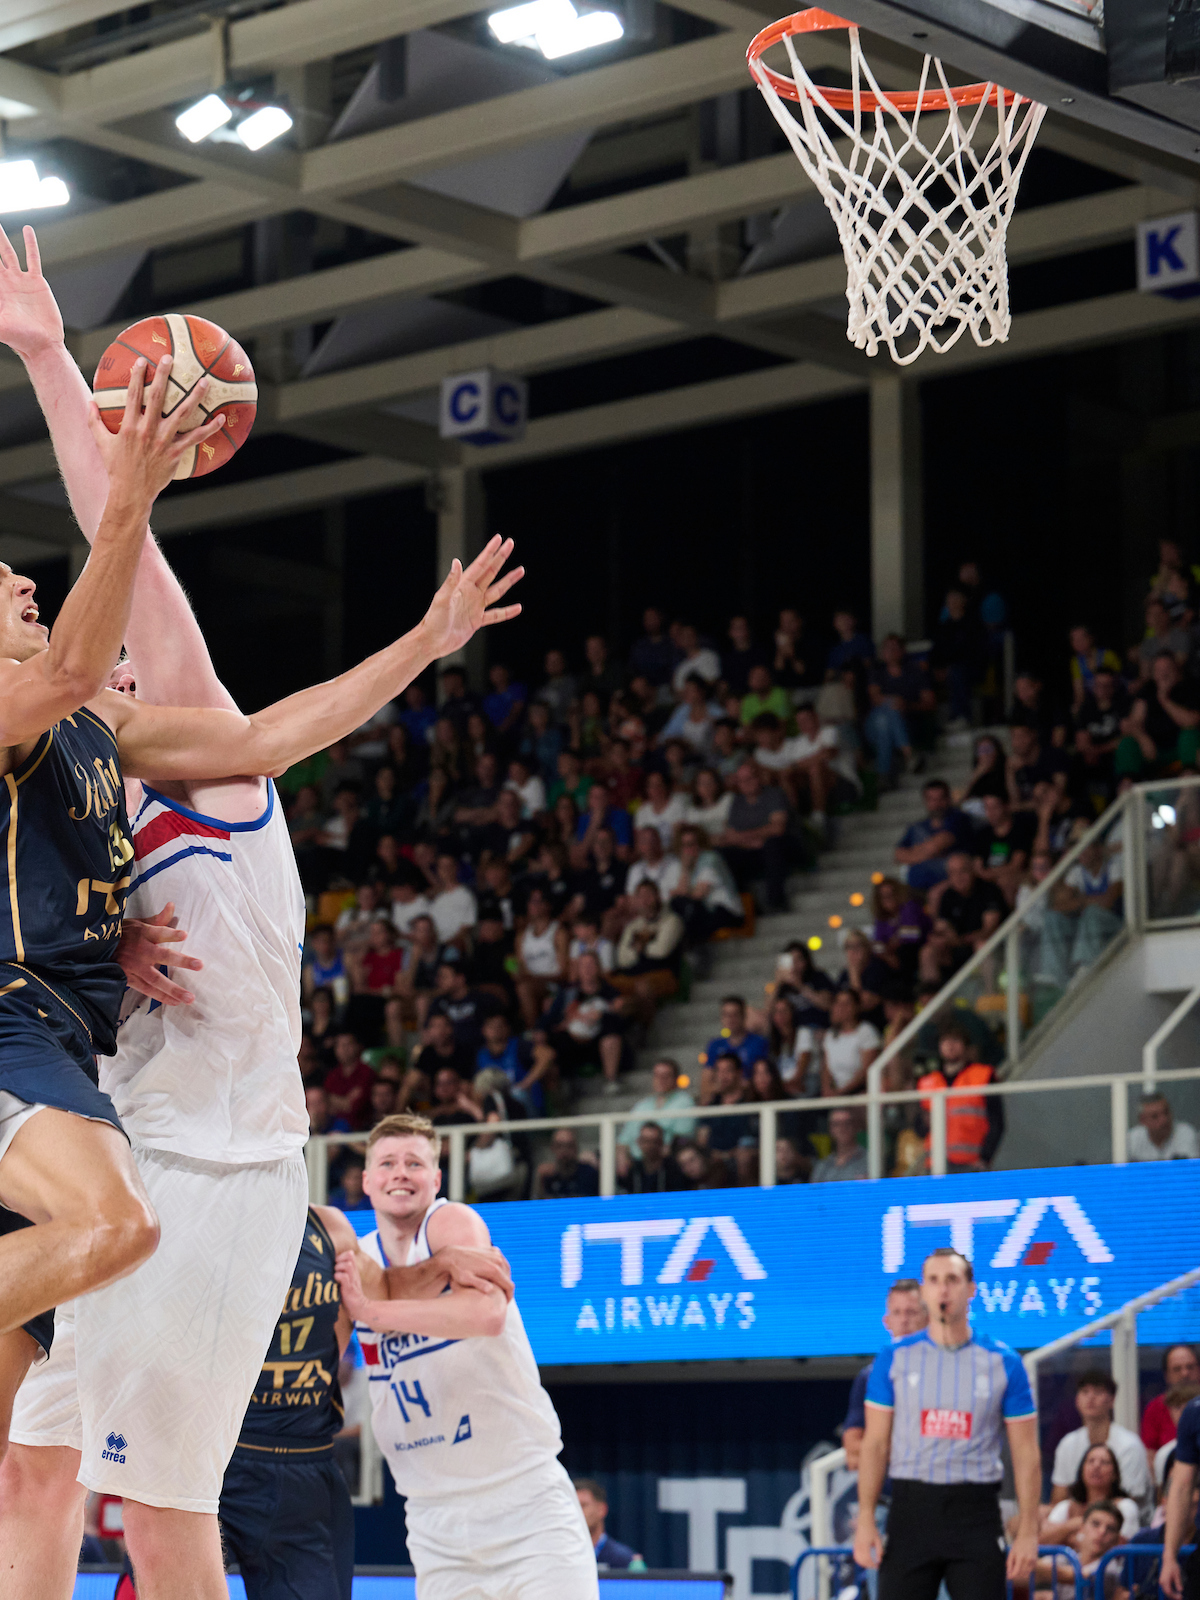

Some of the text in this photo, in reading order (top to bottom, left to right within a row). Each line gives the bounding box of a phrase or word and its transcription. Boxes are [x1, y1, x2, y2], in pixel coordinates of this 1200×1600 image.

[1146, 225, 1186, 277] K
[448, 381, 480, 424] C
[494, 382, 520, 426] C
[75, 875, 132, 917] IT
[560, 1215, 769, 1289] ITA
[882, 1195, 1116, 1274] ITA
[282, 1271, 340, 1314] alia
[574, 1291, 757, 1335] AIRWAYS
[969, 1276, 1103, 1318] WAYS
[279, 1316, 315, 1355] 17
[261, 1359, 332, 1389] TA
[391, 1379, 432, 1423] 14
[101, 1449, 127, 1465] errea
